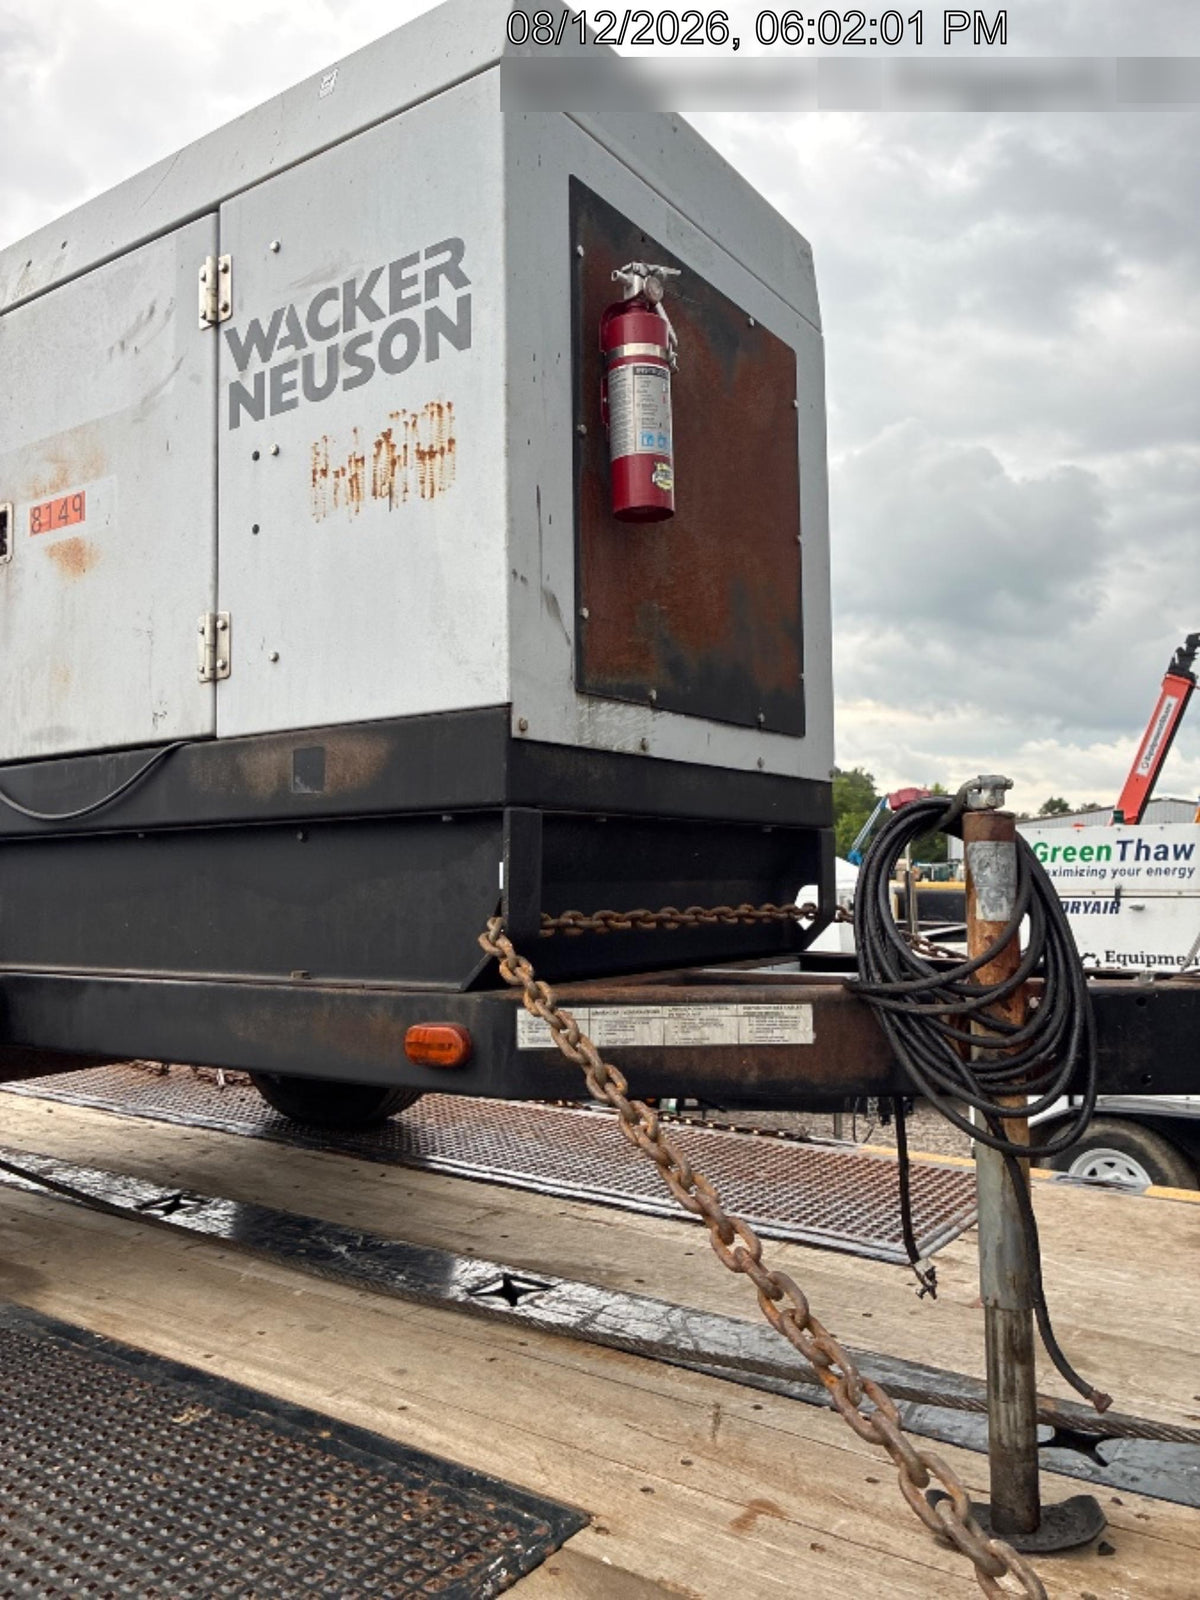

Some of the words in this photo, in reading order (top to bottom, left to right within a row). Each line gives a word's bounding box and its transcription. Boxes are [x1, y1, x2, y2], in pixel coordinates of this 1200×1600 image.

[224, 237, 472, 372] WACKER
[228, 293, 472, 430] NEUSON
[31, 493, 83, 534] 8149
[1033, 842, 1112, 863] Green
[1116, 838, 1195, 862] Thaw
[1111, 868, 1141, 880] your
[1146, 866, 1195, 880] energy
